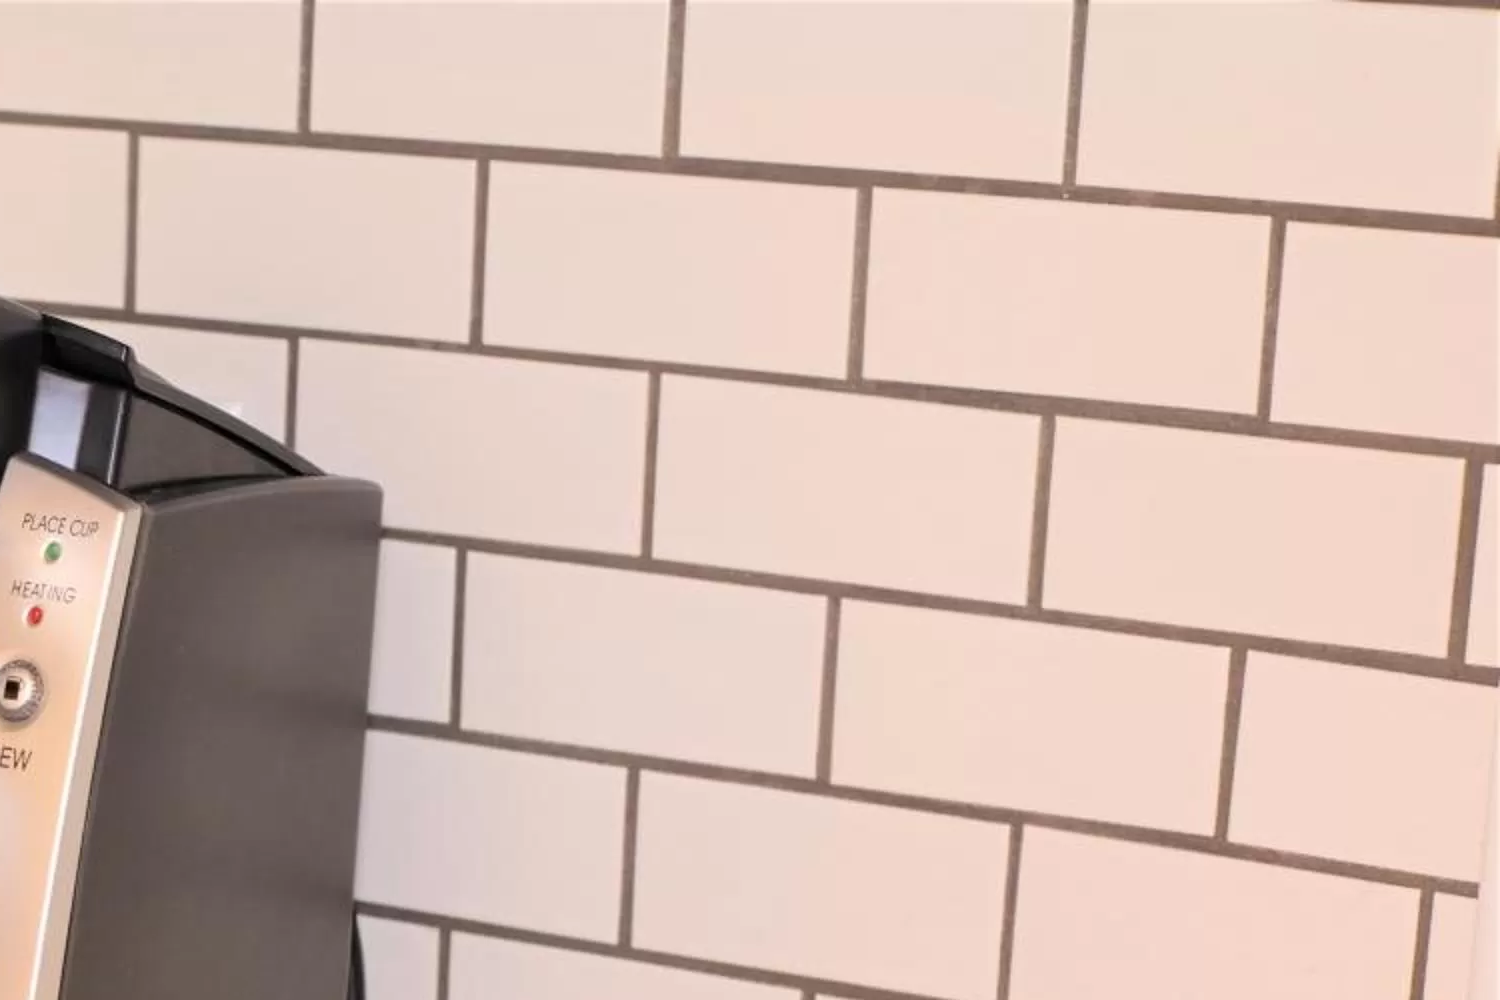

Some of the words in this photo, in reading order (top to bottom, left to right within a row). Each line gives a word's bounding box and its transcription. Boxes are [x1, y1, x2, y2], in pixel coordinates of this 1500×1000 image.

[21, 513, 67, 535] PLACE
[69, 519, 100, 537] CUP
[11, 579, 77, 604] HEATING
